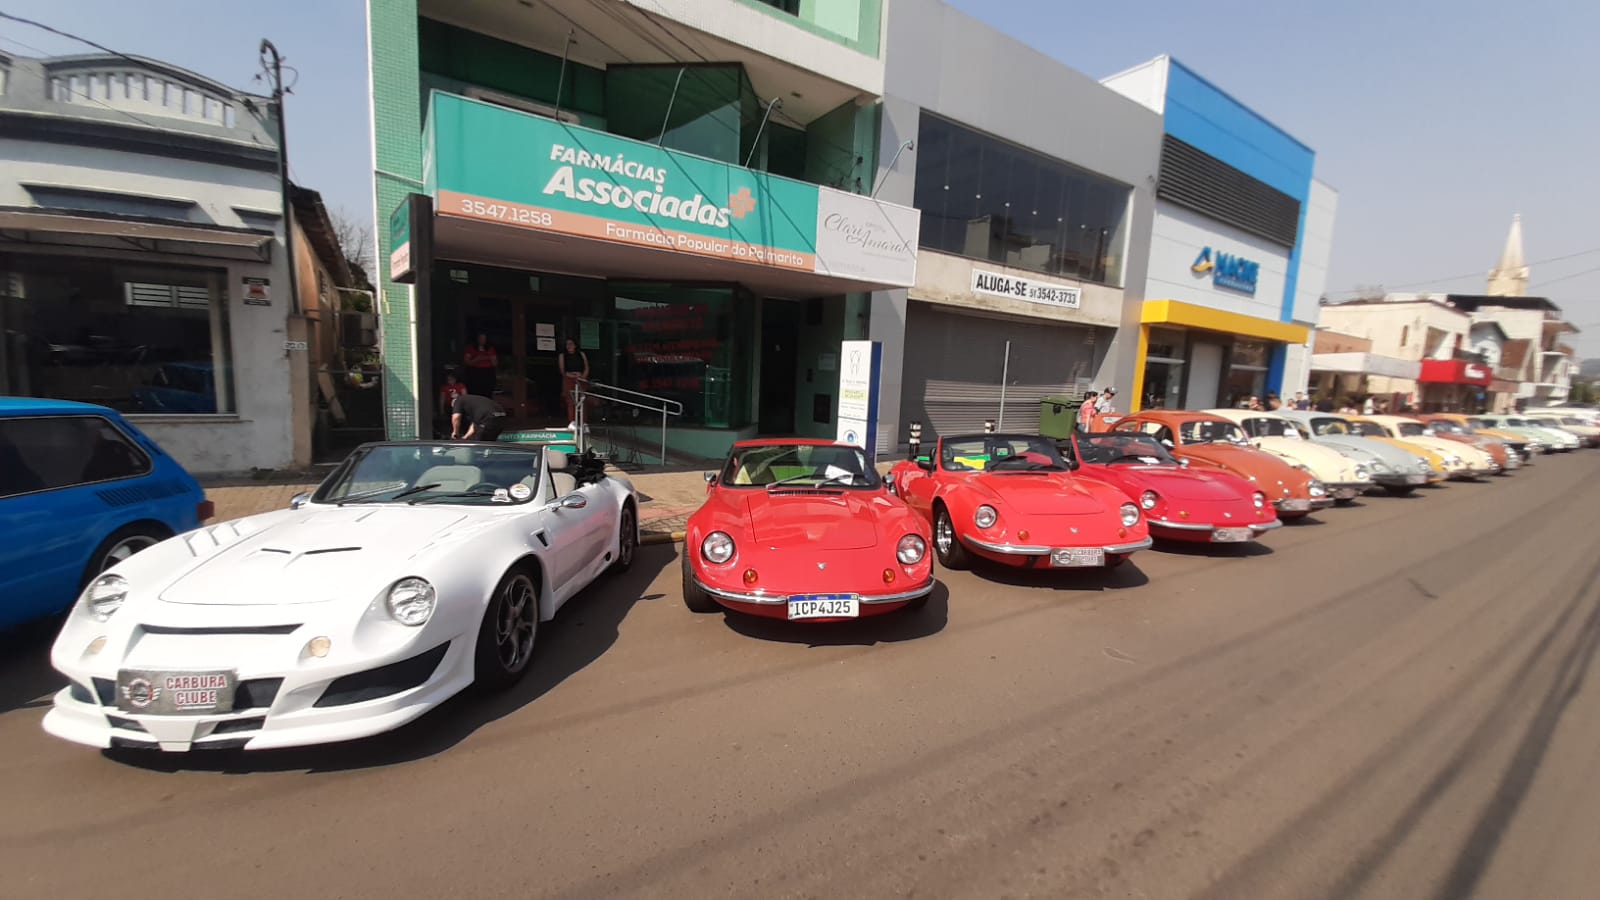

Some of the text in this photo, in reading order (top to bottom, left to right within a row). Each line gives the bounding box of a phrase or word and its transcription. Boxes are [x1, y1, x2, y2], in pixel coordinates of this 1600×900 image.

[550, 144, 666, 183] FARMÁCIAS
[542, 166, 732, 228] Associadas
[462, 199, 552, 227] 3547.1258
[606, 223, 676, 246] Farmácia
[678, 235, 728, 254] Popular
[748, 246, 804, 266] Palmarito
[976, 274, 1027, 297] ALUGA-SE
[1037, 288, 1077, 305] 3542-3733
[794, 600, 850, 616] ICP4J25
[166, 675, 226, 690] CARBURA
[175, 690, 217, 705] CLUBE
